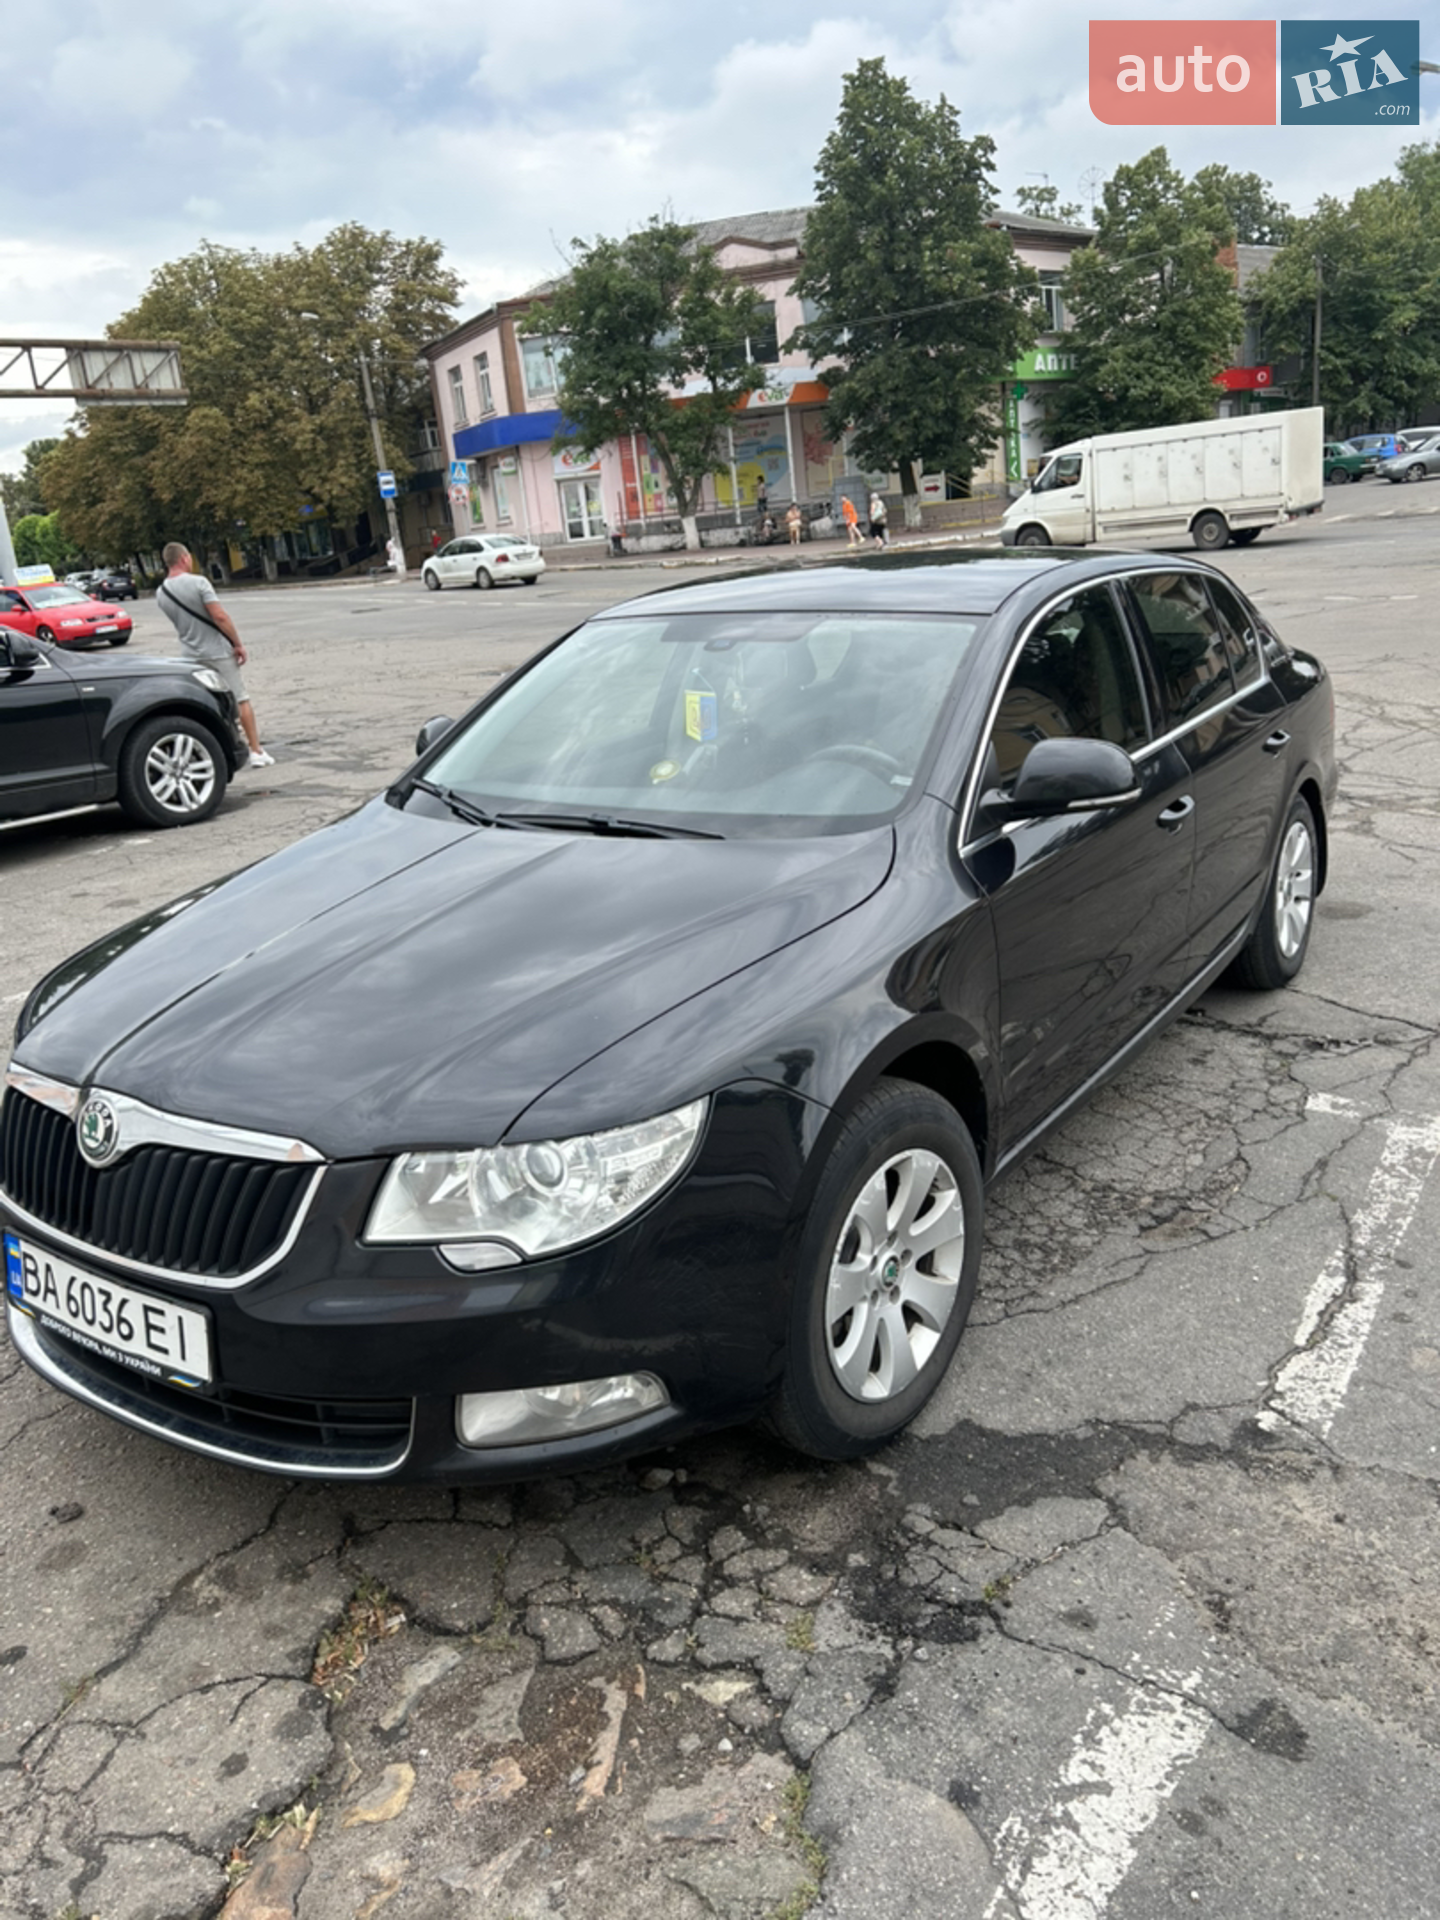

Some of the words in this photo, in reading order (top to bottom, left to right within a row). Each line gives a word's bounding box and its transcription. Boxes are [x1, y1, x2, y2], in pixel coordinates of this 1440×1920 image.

[1034, 352, 1079, 371] АПТЕ
[22, 1252, 60, 1309] BA
[66, 1276, 135, 1341] 6036
[143, 1303, 186, 1362] EI
